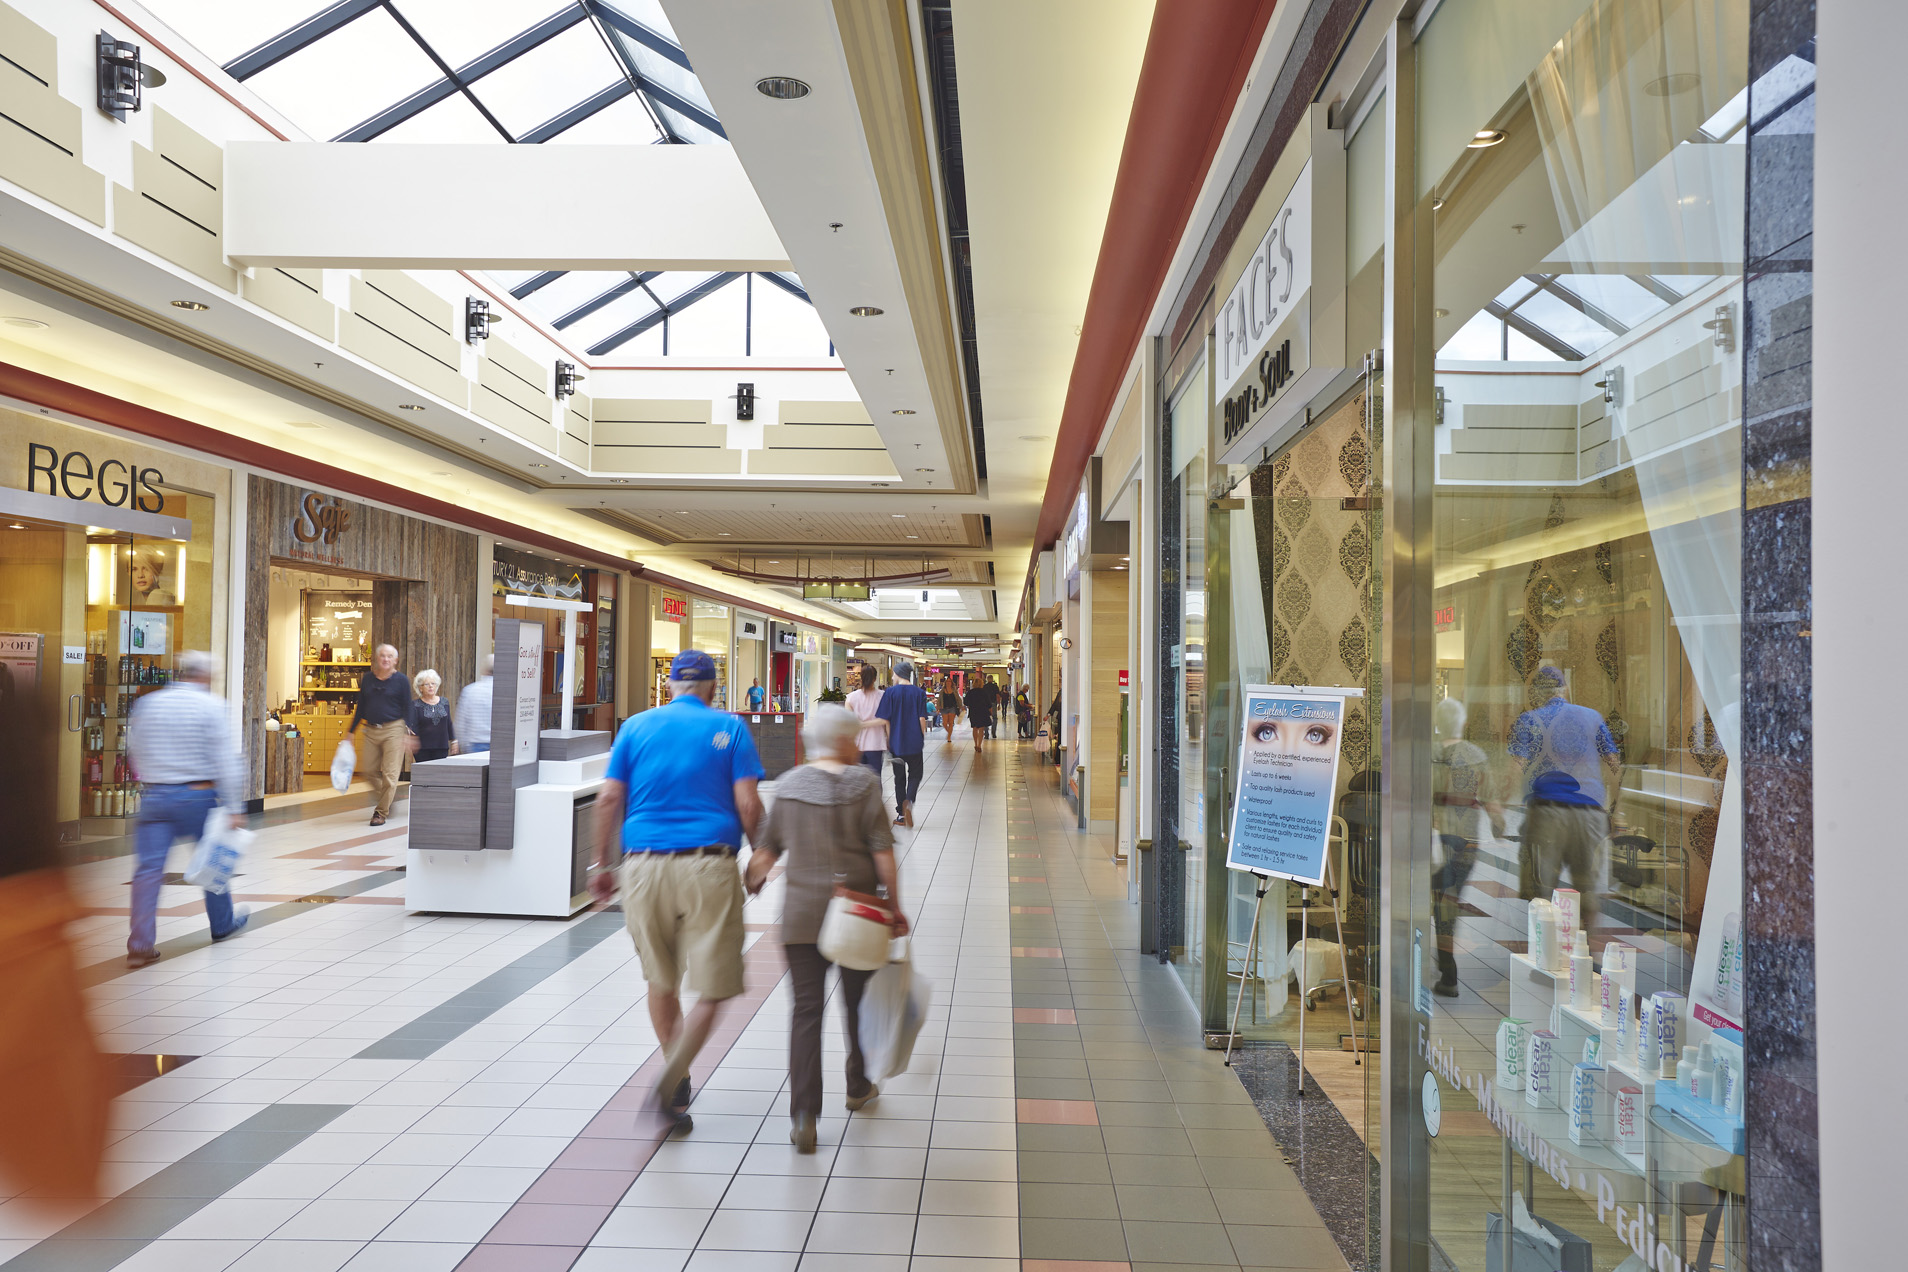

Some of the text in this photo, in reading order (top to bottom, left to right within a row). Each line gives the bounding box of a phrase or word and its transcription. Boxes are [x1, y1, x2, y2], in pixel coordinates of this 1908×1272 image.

[1224, 208, 1293, 380] FACES
[293, 493, 351, 545] Saje
[289, 549, 314, 560] NATURAL
[516, 567, 544, 585] Assurance
[325, 600, 356, 609] Remedy
[664, 597, 687, 617] GNC
[11, 641, 34, 651] OFF
[519, 646, 528, 658] Got
[65, 652, 83, 660] SALE!
[1254, 702, 1335, 722] Eyelash Extensions
[1253, 751, 1271, 759] Applied
[1270, 759, 1293, 767] Technician
[1258, 785, 1273, 793] quality
[1283, 788, 1303, 796] products
[1248, 796, 1272, 805] Waterproof
[1246, 809, 1261, 817] Various
[1279, 814, 1295, 822] weights
[1246, 817, 1266, 825] customize
[1300, 824, 1322, 834] individual
[1250, 832, 1266, 840] natural
[1266, 834, 1280, 842] lashes
[1278, 829, 1292, 838] quality
[1293, 831, 1303, 839] and
[1303, 833, 1317, 842] safety
[1241, 852, 1260, 860] between
[1262, 846, 1279, 856] relaxing
[1280, 850, 1296, 858] service
[1559, 897, 1574, 953] start
[1718, 935, 1731, 985] clear
[1602, 973, 1611, 1009] start
[1703, 1010, 1711, 1020] Get
[1711, 1014, 1721, 1028] your
[1663, 1001, 1678, 1060] start
[1505, 1025, 1517, 1076] clear
[1530, 1038, 1540, 1092] clear
[1539, 1040, 1553, 1093] start
[1573, 1070, 1582, 1128] clear
[1580, 1072, 1596, 1130] start
[1617, 1094, 1625, 1136] clear
[1624, 1096, 1636, 1137] start
